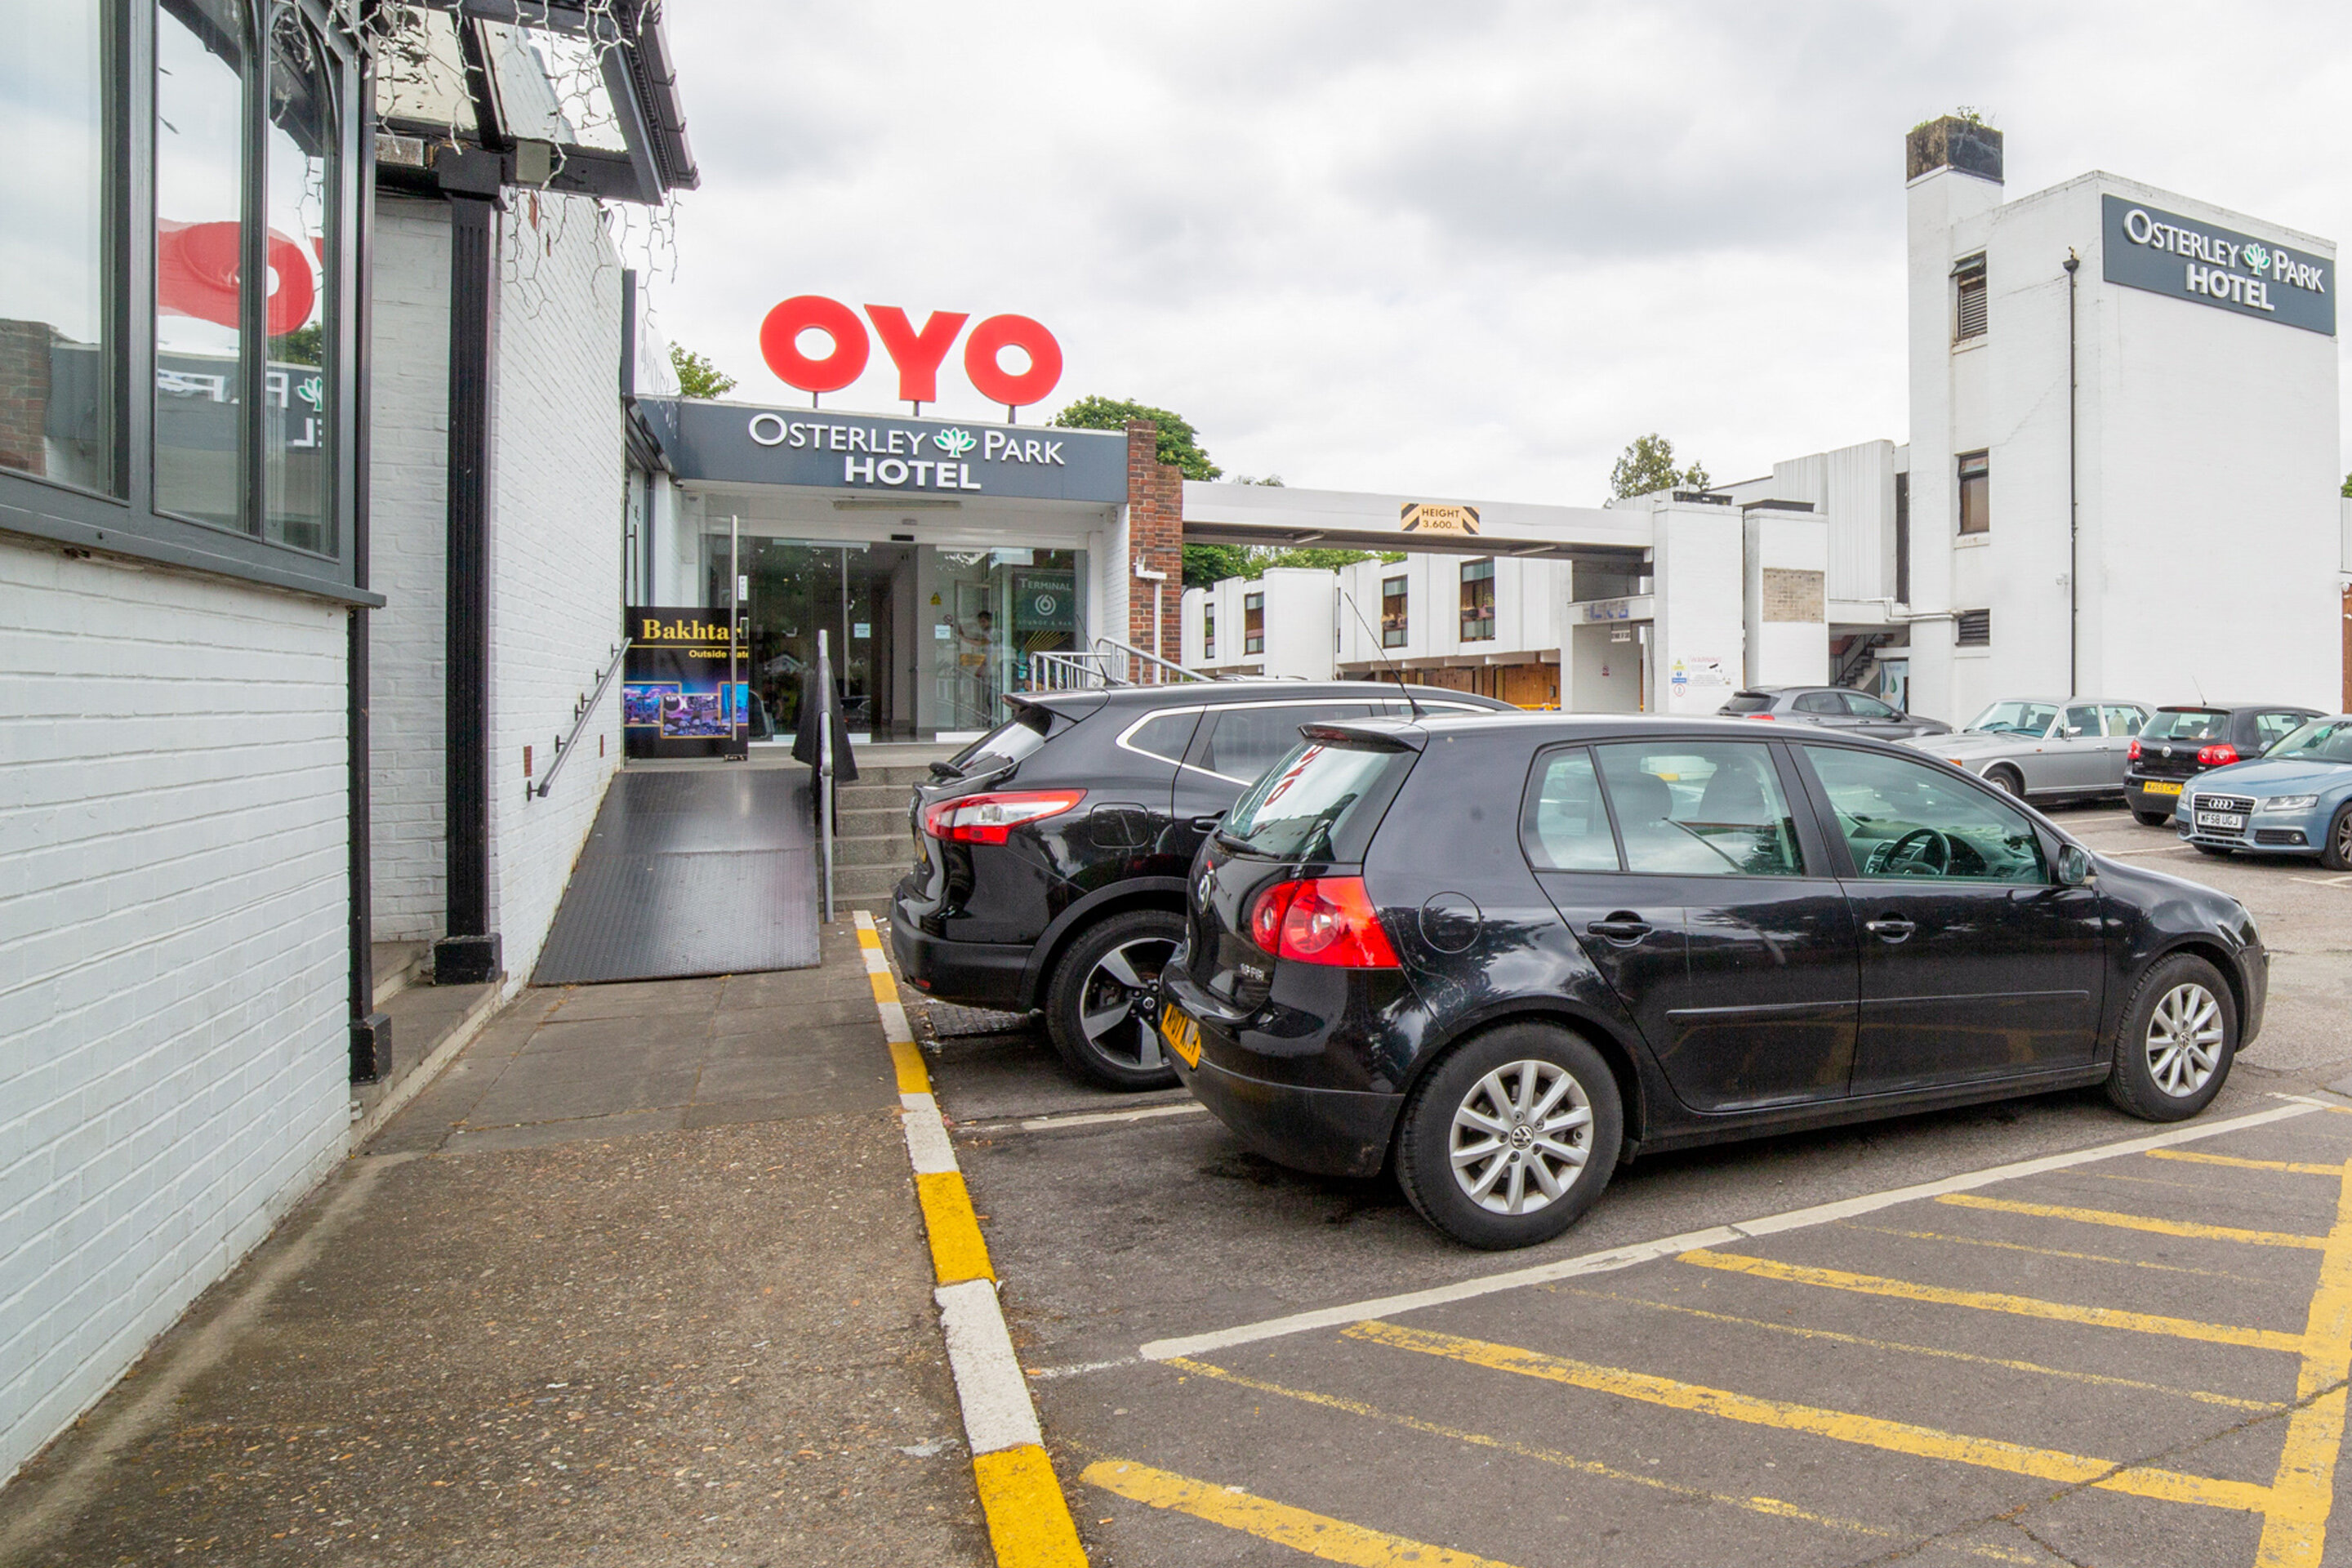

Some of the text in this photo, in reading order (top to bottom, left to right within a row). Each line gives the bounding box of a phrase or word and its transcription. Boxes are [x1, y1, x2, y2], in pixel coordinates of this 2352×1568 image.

[2123, 209, 2325, 293] OSTERLEY PARK
[2185, 263, 2275, 312] HOTEL
[760, 294, 1063, 407] OYO
[748, 412, 1066, 466] OSTERLEY PARK
[844, 456, 982, 490] HOTEL
[1422, 508, 1459, 518] HEIGHT
[1018, 577, 1072, 591] TERMINAL
[688, 649, 727, 658] Outside
[2200, 813, 2239, 826] WF58 UGJ
